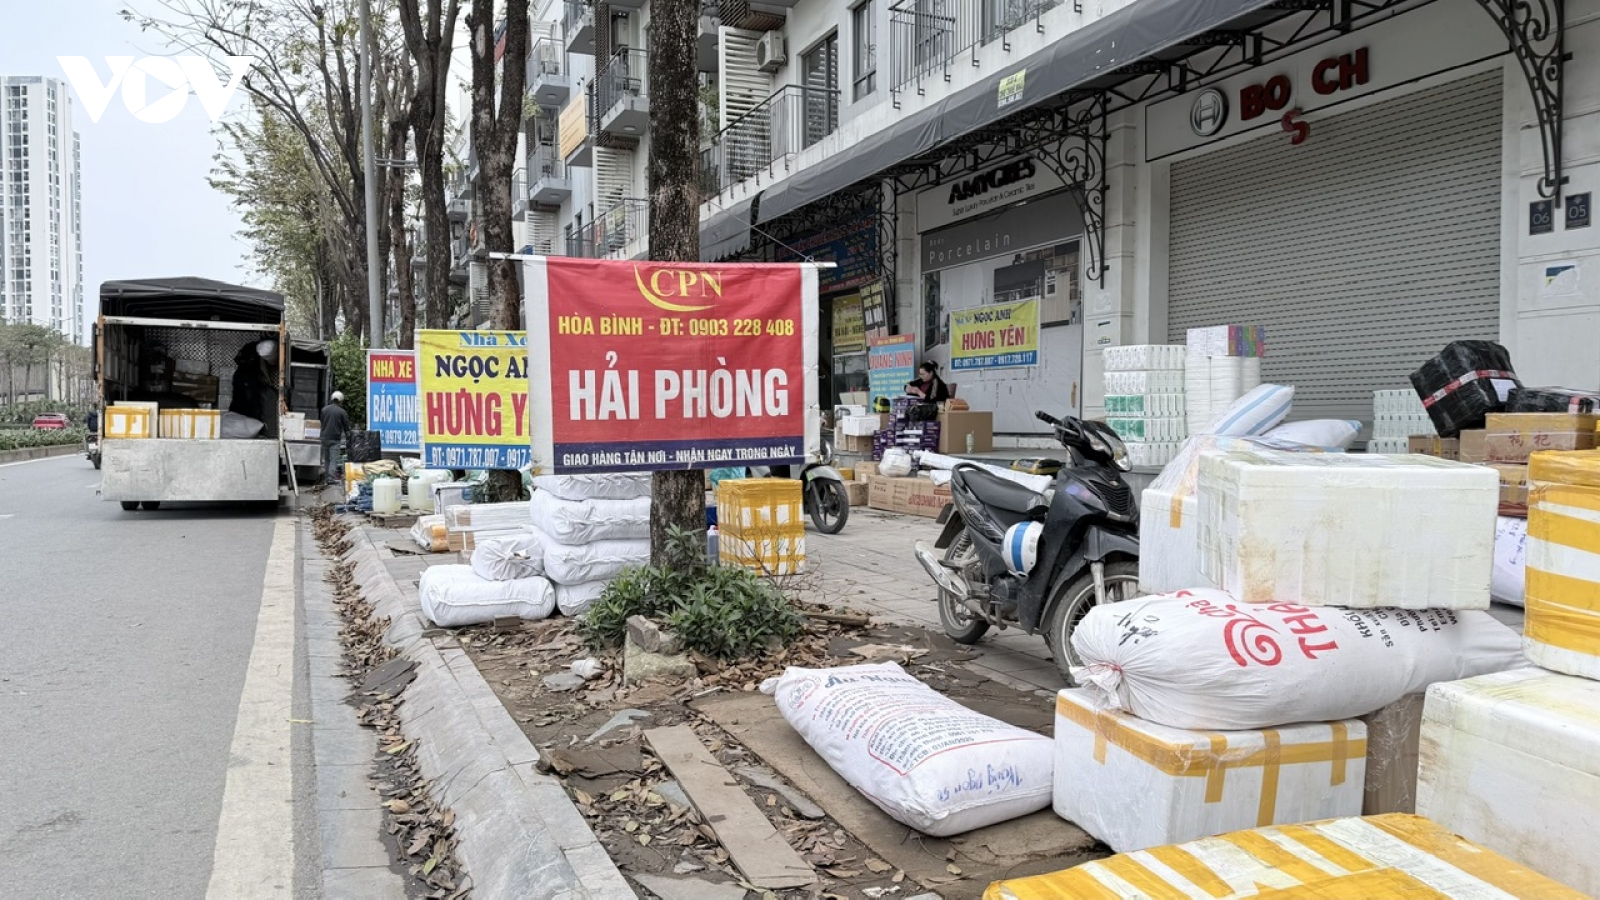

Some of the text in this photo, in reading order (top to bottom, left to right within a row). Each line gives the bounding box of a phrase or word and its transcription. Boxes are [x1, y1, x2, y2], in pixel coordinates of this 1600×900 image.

[1532, 212, 1550, 225] 06
[1568, 204, 1587, 219] 05
[929, 233, 1011, 265] Porcelain
[650, 269, 723, 298] CPN
[558, 312, 595, 336] HÒA
[600, 313, 643, 336] BÌNH
[659, 318, 685, 336] ĐT:
[689, 318, 728, 336] 0903
[733, 318, 763, 336] 228
[765, 318, 795, 336] 408
[995, 308, 1012, 321] ANH
[460, 332, 497, 346] Nhà
[962, 324, 1025, 351] HƯNG YÊN
[373, 356, 413, 379] NHÀ XE
[435, 354, 500, 384] NGỌC
[568, 350, 789, 421] HẢI PHÒNG
[373, 384, 393, 422] BẮC
[426, 387, 531, 437] HƯNG Y
[445, 446, 500, 467] 0971.787.007
[563, 452, 590, 466] GIAO
[592, 449, 622, 466] HÀNG
[623, 448, 646, 467] TẬN
[647, 448, 666, 463] NƠI
[675, 447, 704, 465] NHẬN
[706, 449, 733, 462] NGAY
[735, 447, 767, 461] TRONG
[769, 444, 796, 460] NGÀY
